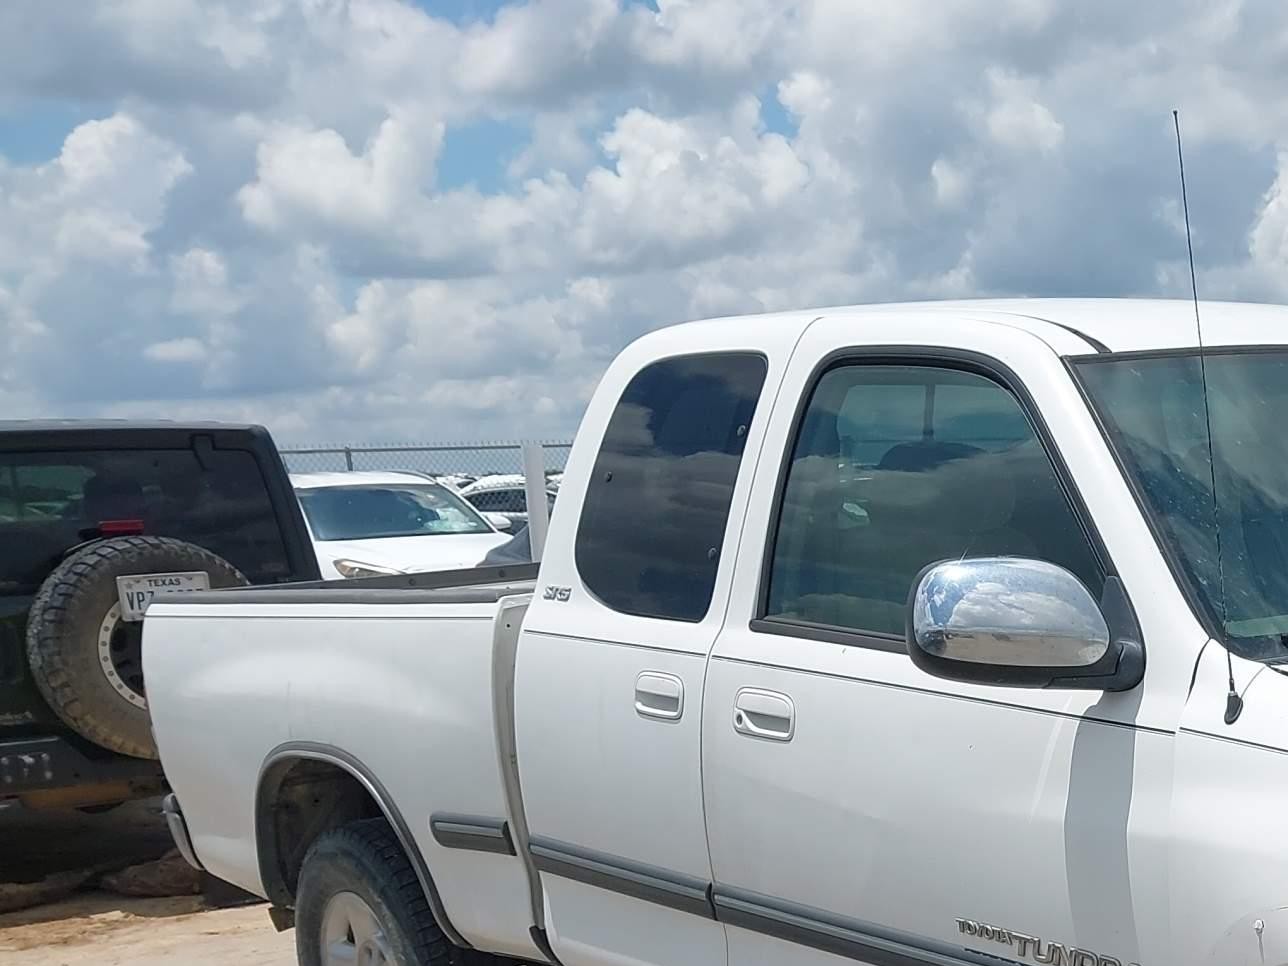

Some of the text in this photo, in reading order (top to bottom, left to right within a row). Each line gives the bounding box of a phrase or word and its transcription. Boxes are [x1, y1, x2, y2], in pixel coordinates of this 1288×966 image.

[147, 578, 182, 588] TEXAS
[543, 584, 572, 602] SR5
[955, 917, 1014, 946] TOYOTA
